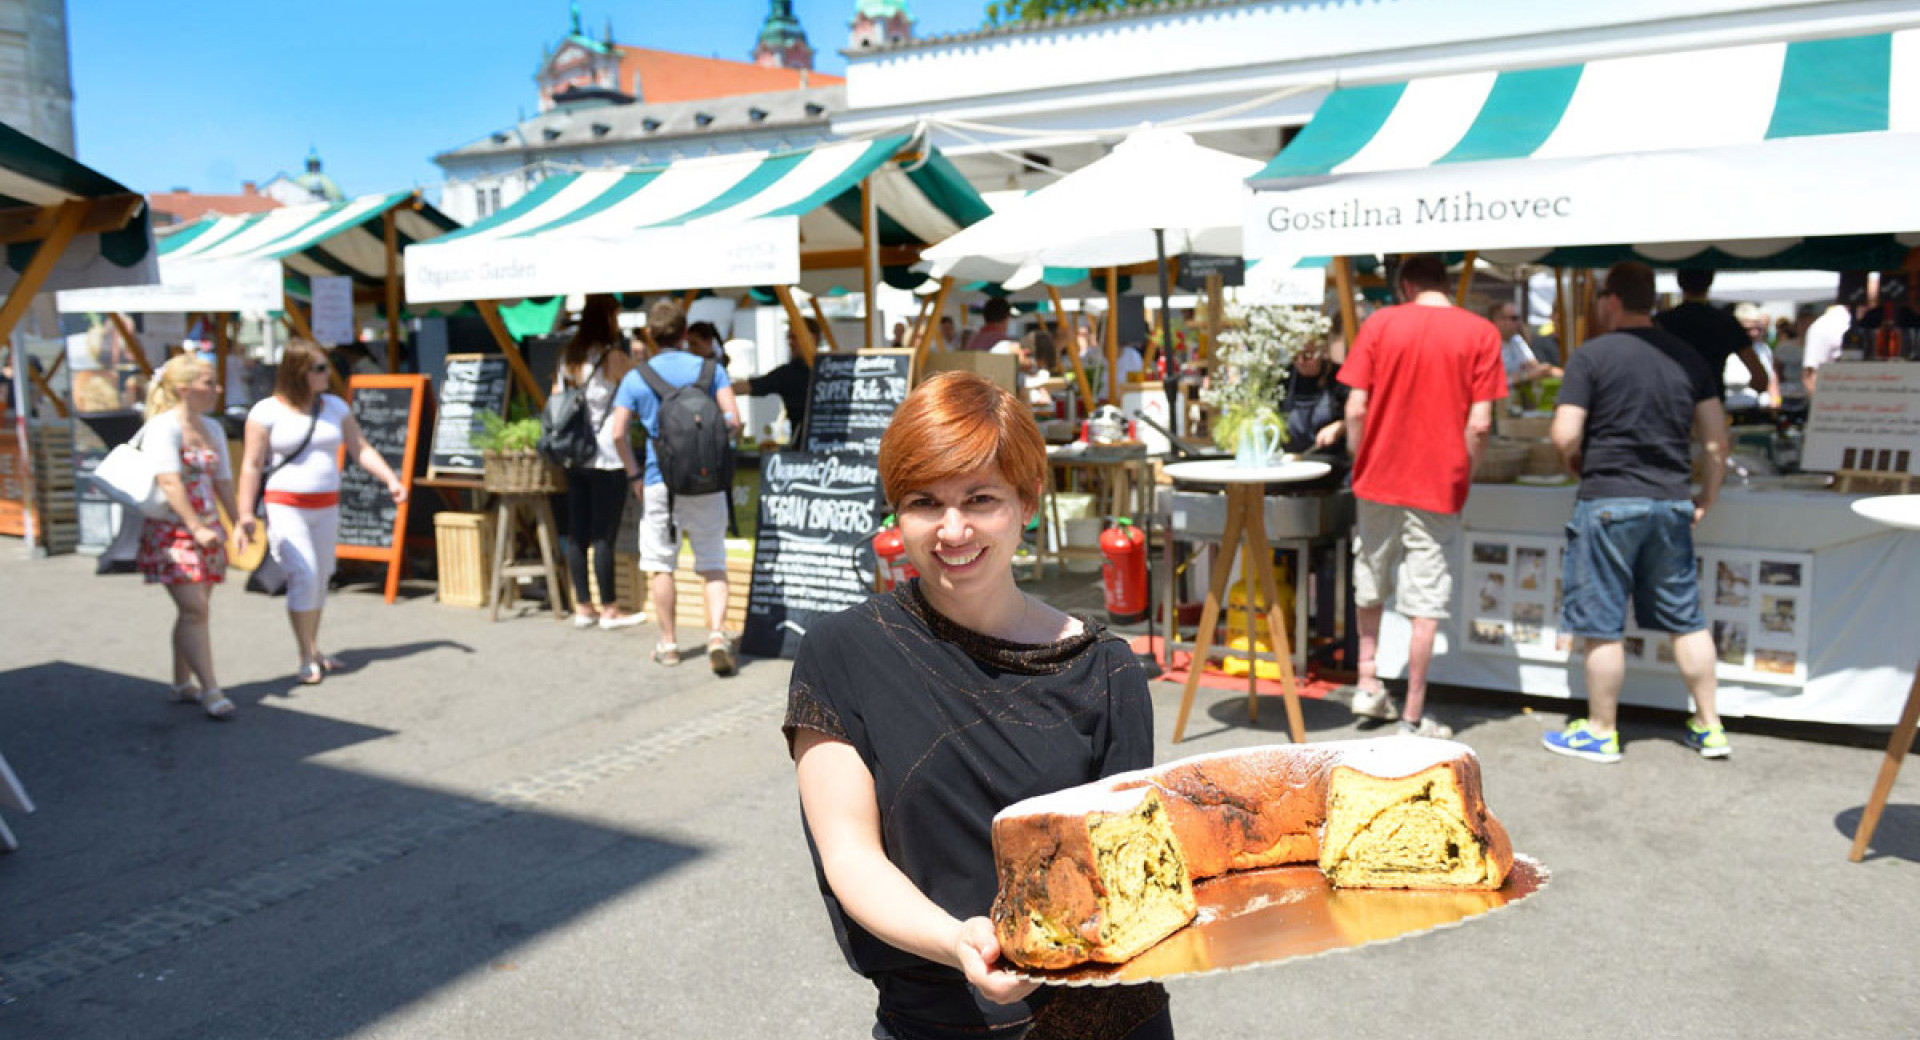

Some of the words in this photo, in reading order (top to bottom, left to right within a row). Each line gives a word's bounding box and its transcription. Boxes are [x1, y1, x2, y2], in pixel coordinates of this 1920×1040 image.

[1267, 198, 1402, 232] Gostilna
[1415, 191, 1572, 224] Mihovec
[814, 380, 851, 402] SUPER
